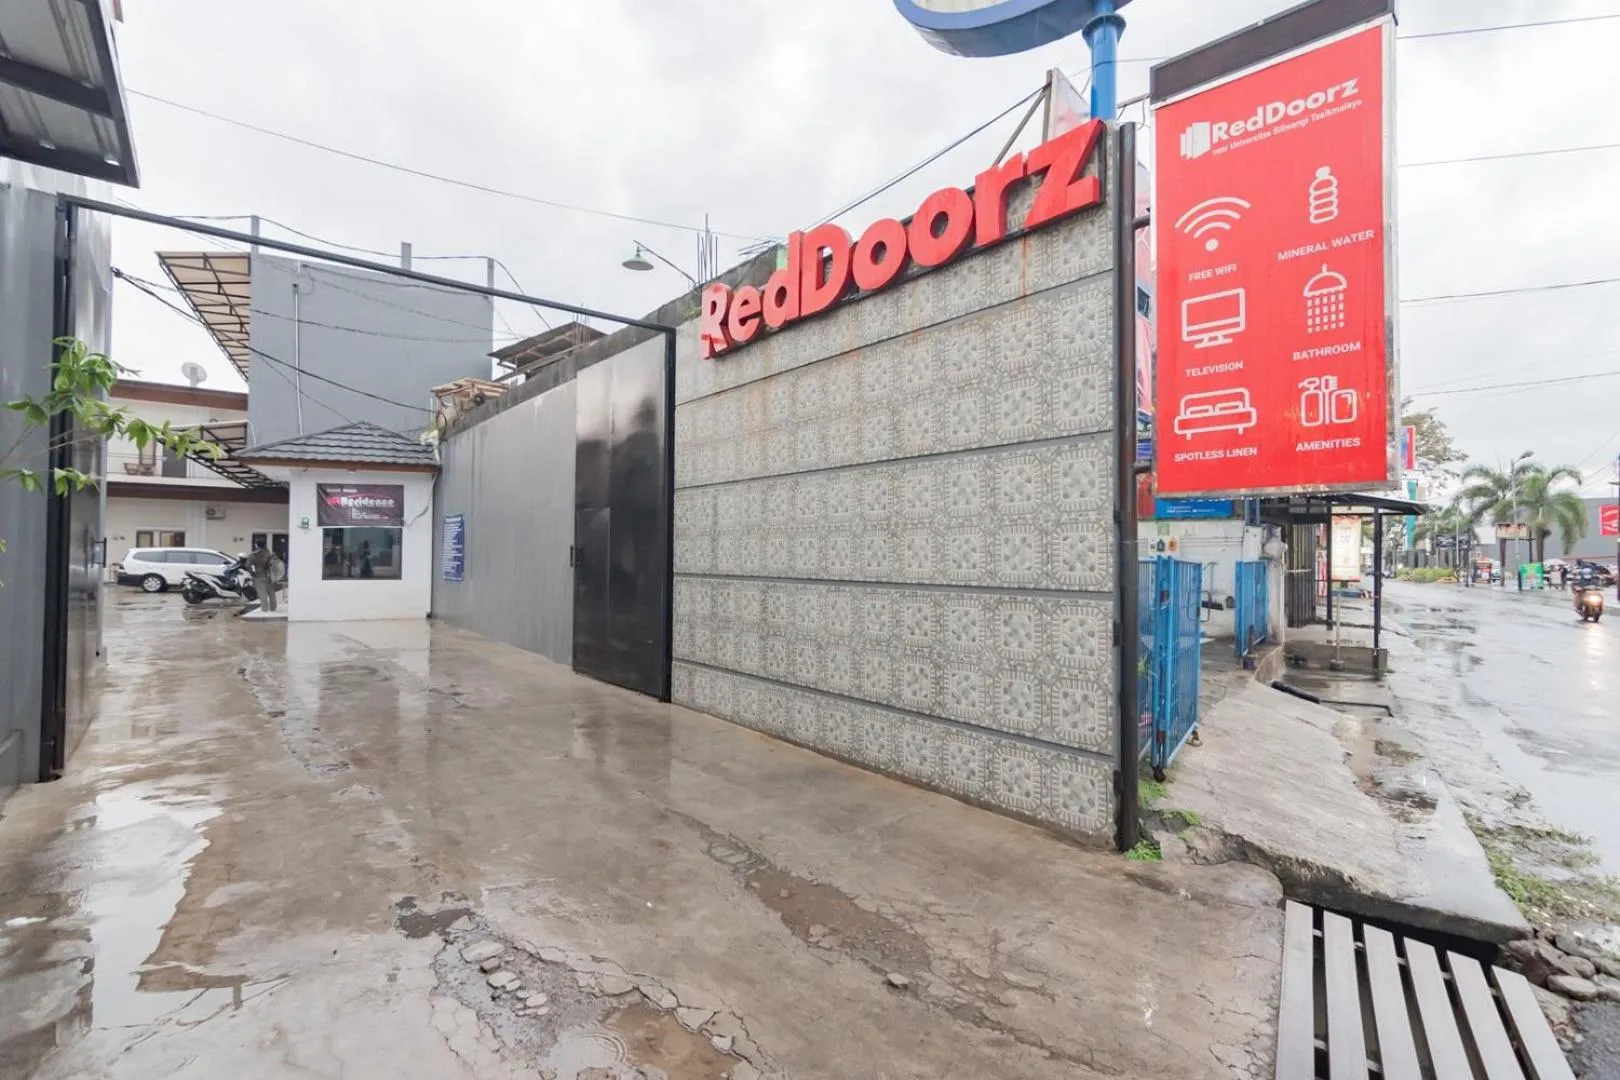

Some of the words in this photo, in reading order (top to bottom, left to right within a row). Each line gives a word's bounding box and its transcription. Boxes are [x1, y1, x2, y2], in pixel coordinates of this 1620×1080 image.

[1211, 78, 1360, 144] RedDoorz
[1229, 130, 1272, 150] Universitas
[701, 119, 1105, 359] RedDoorz
[1277, 242, 1329, 262] MINERAL
[1331, 229, 1375, 249] WATER
[1188, 268, 1213, 282] FREE
[1215, 264, 1237, 277] WIFI
[1292, 341, 1361, 362] BATHROOM
[1185, 360, 1244, 378] TELEVISION
[1174, 449, 1226, 463] SPOTLESS
[1226, 446, 1258, 459] LINEN
[1296, 437, 1361, 452] AMENITIES
